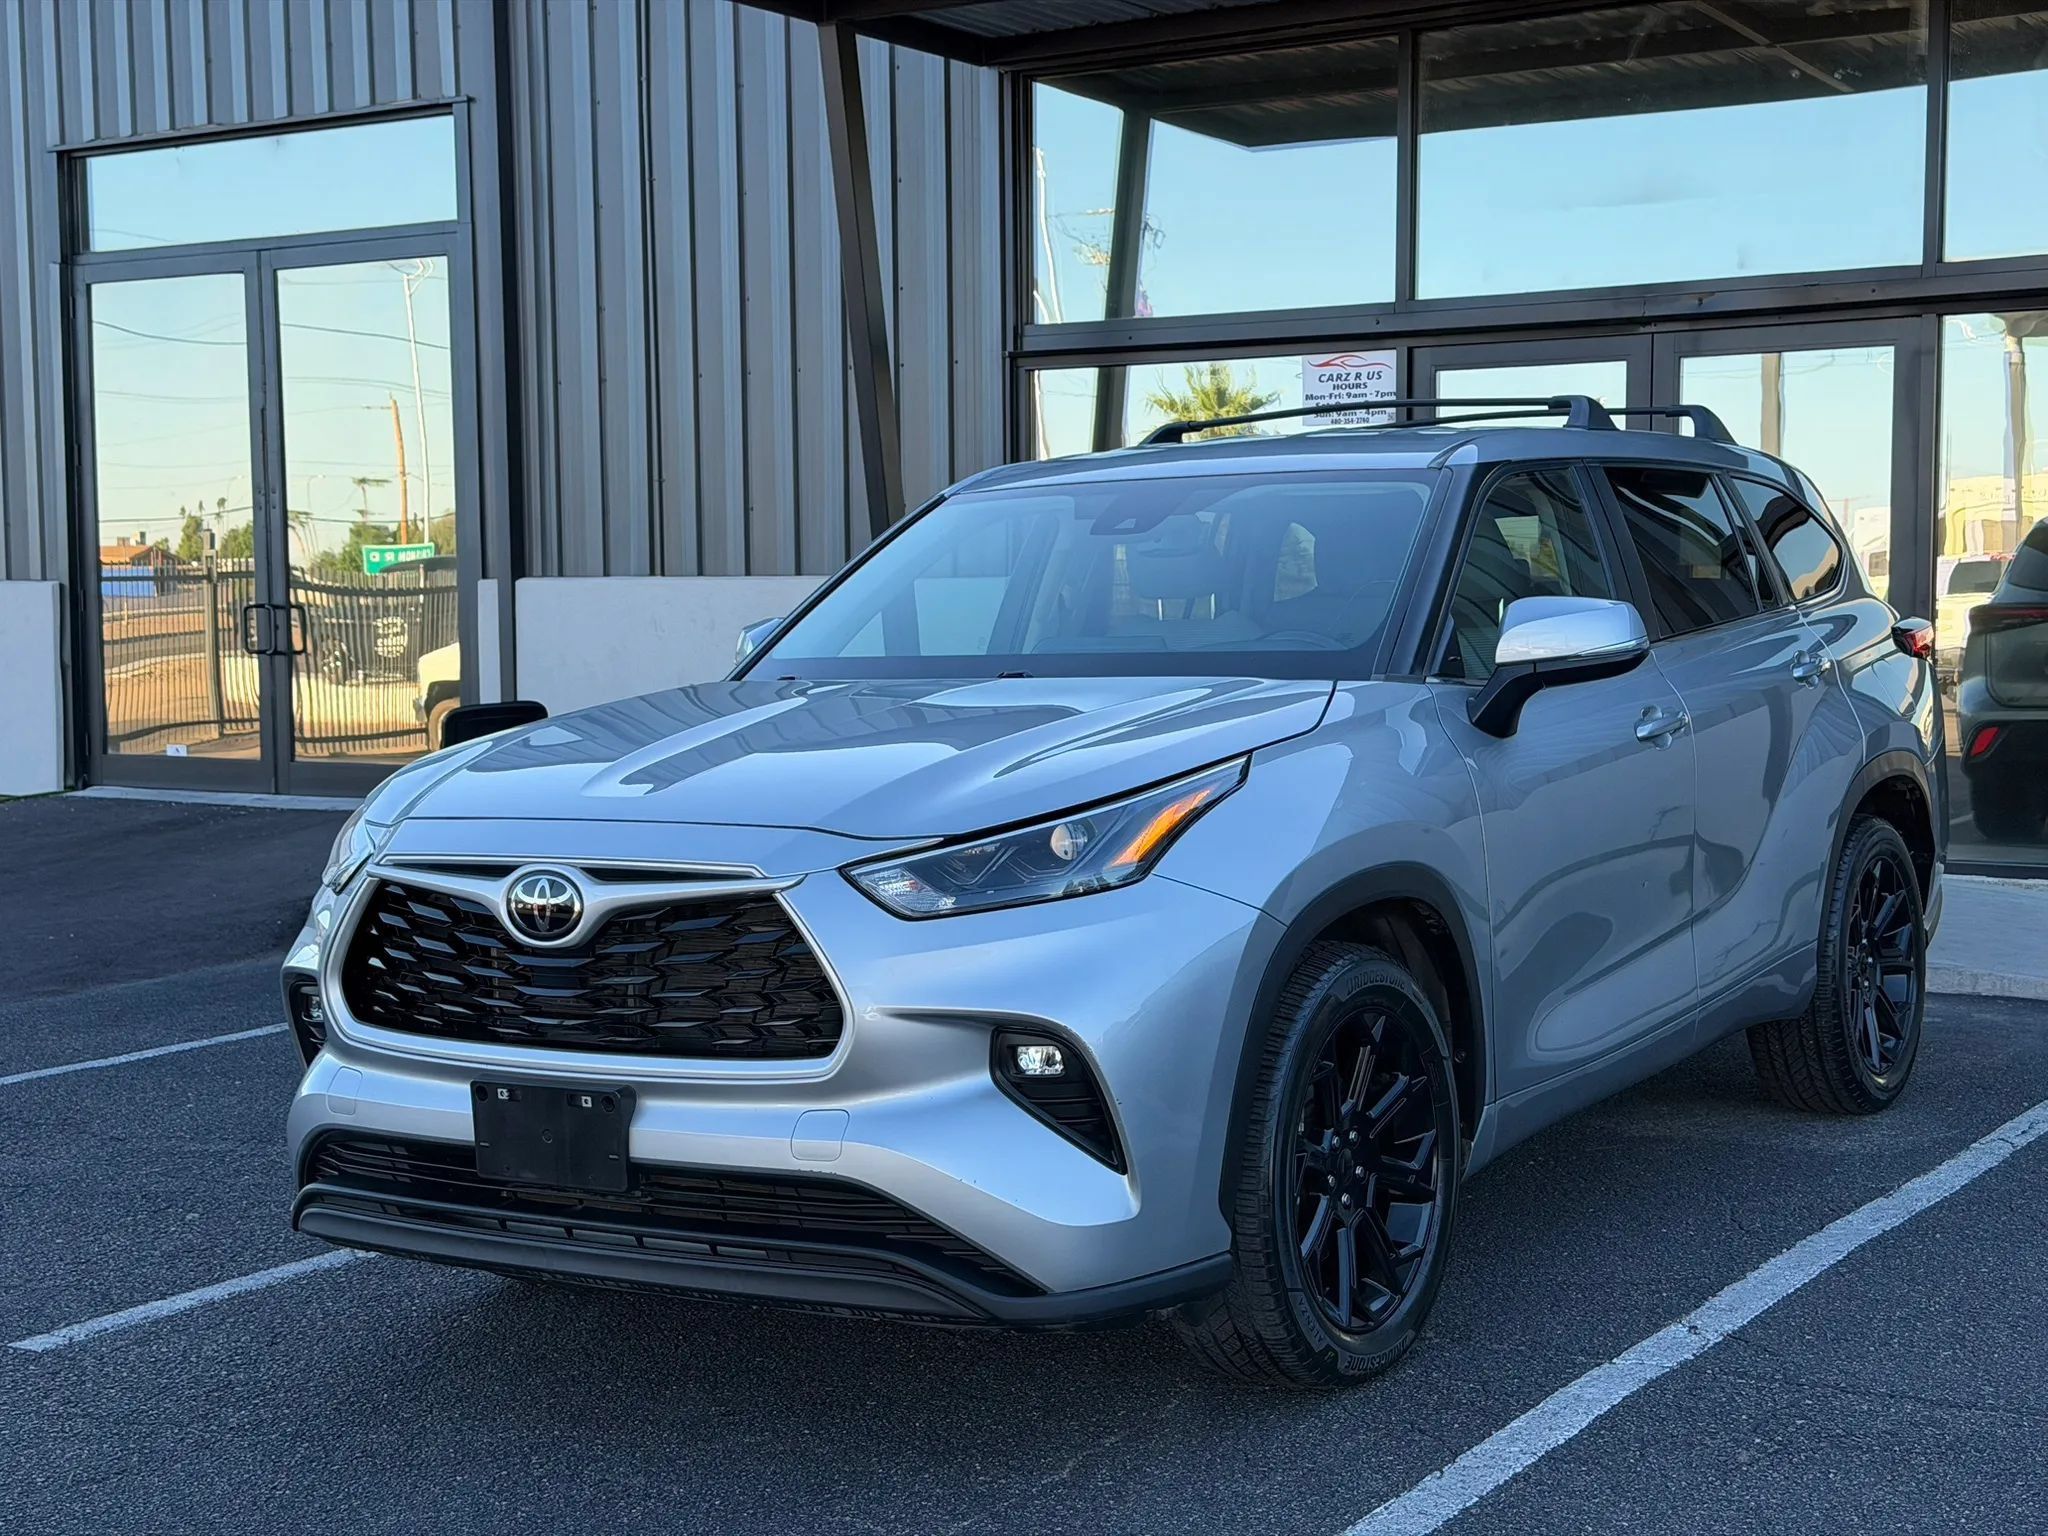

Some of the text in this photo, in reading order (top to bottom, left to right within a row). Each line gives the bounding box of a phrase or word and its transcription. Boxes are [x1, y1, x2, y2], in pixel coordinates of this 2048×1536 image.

[1318, 371, 1382, 382] CARZ R US
[1346, 391, 1368, 399] 9am
[1374, 390, 1396, 399] 7pm
[1364, 408, 1387, 417] 4pm
